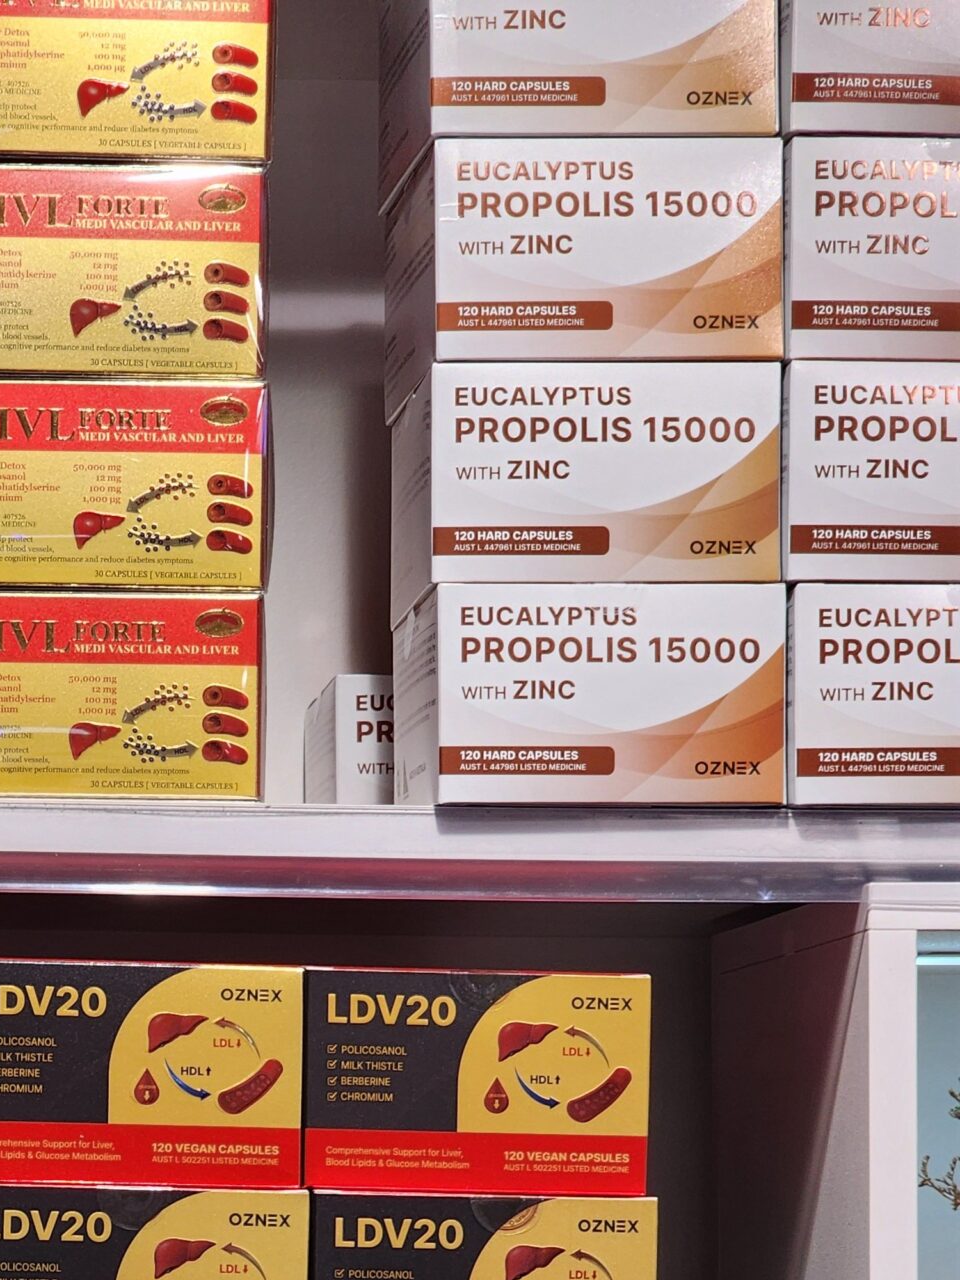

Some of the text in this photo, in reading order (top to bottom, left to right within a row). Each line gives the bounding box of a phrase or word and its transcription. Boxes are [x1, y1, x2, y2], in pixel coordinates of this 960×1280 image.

[458, 162, 634, 181] EUCALYPTUS
[75, 194, 170, 218] FORTE
[458, 190, 758, 218] PROPOLIS 15000
[459, 235, 573, 255] WITH ZINC
[458, 306, 576, 317] 120 HARD CAPSULES
[457, 318, 585, 328] AUST L 447961 LISTED MEDICINE
[693, 314, 760, 331] OZNEX
[461, 607, 637, 626] EUCALYPTUS
[461, 637, 761, 664] PROPOLIS 15000
[462, 680, 575, 700] WITH ZINC
[695, 761, 761, 777] OZNEX
[572, 996, 633, 1011] OZNEX
[335, 1217, 464, 1248] LDV20
